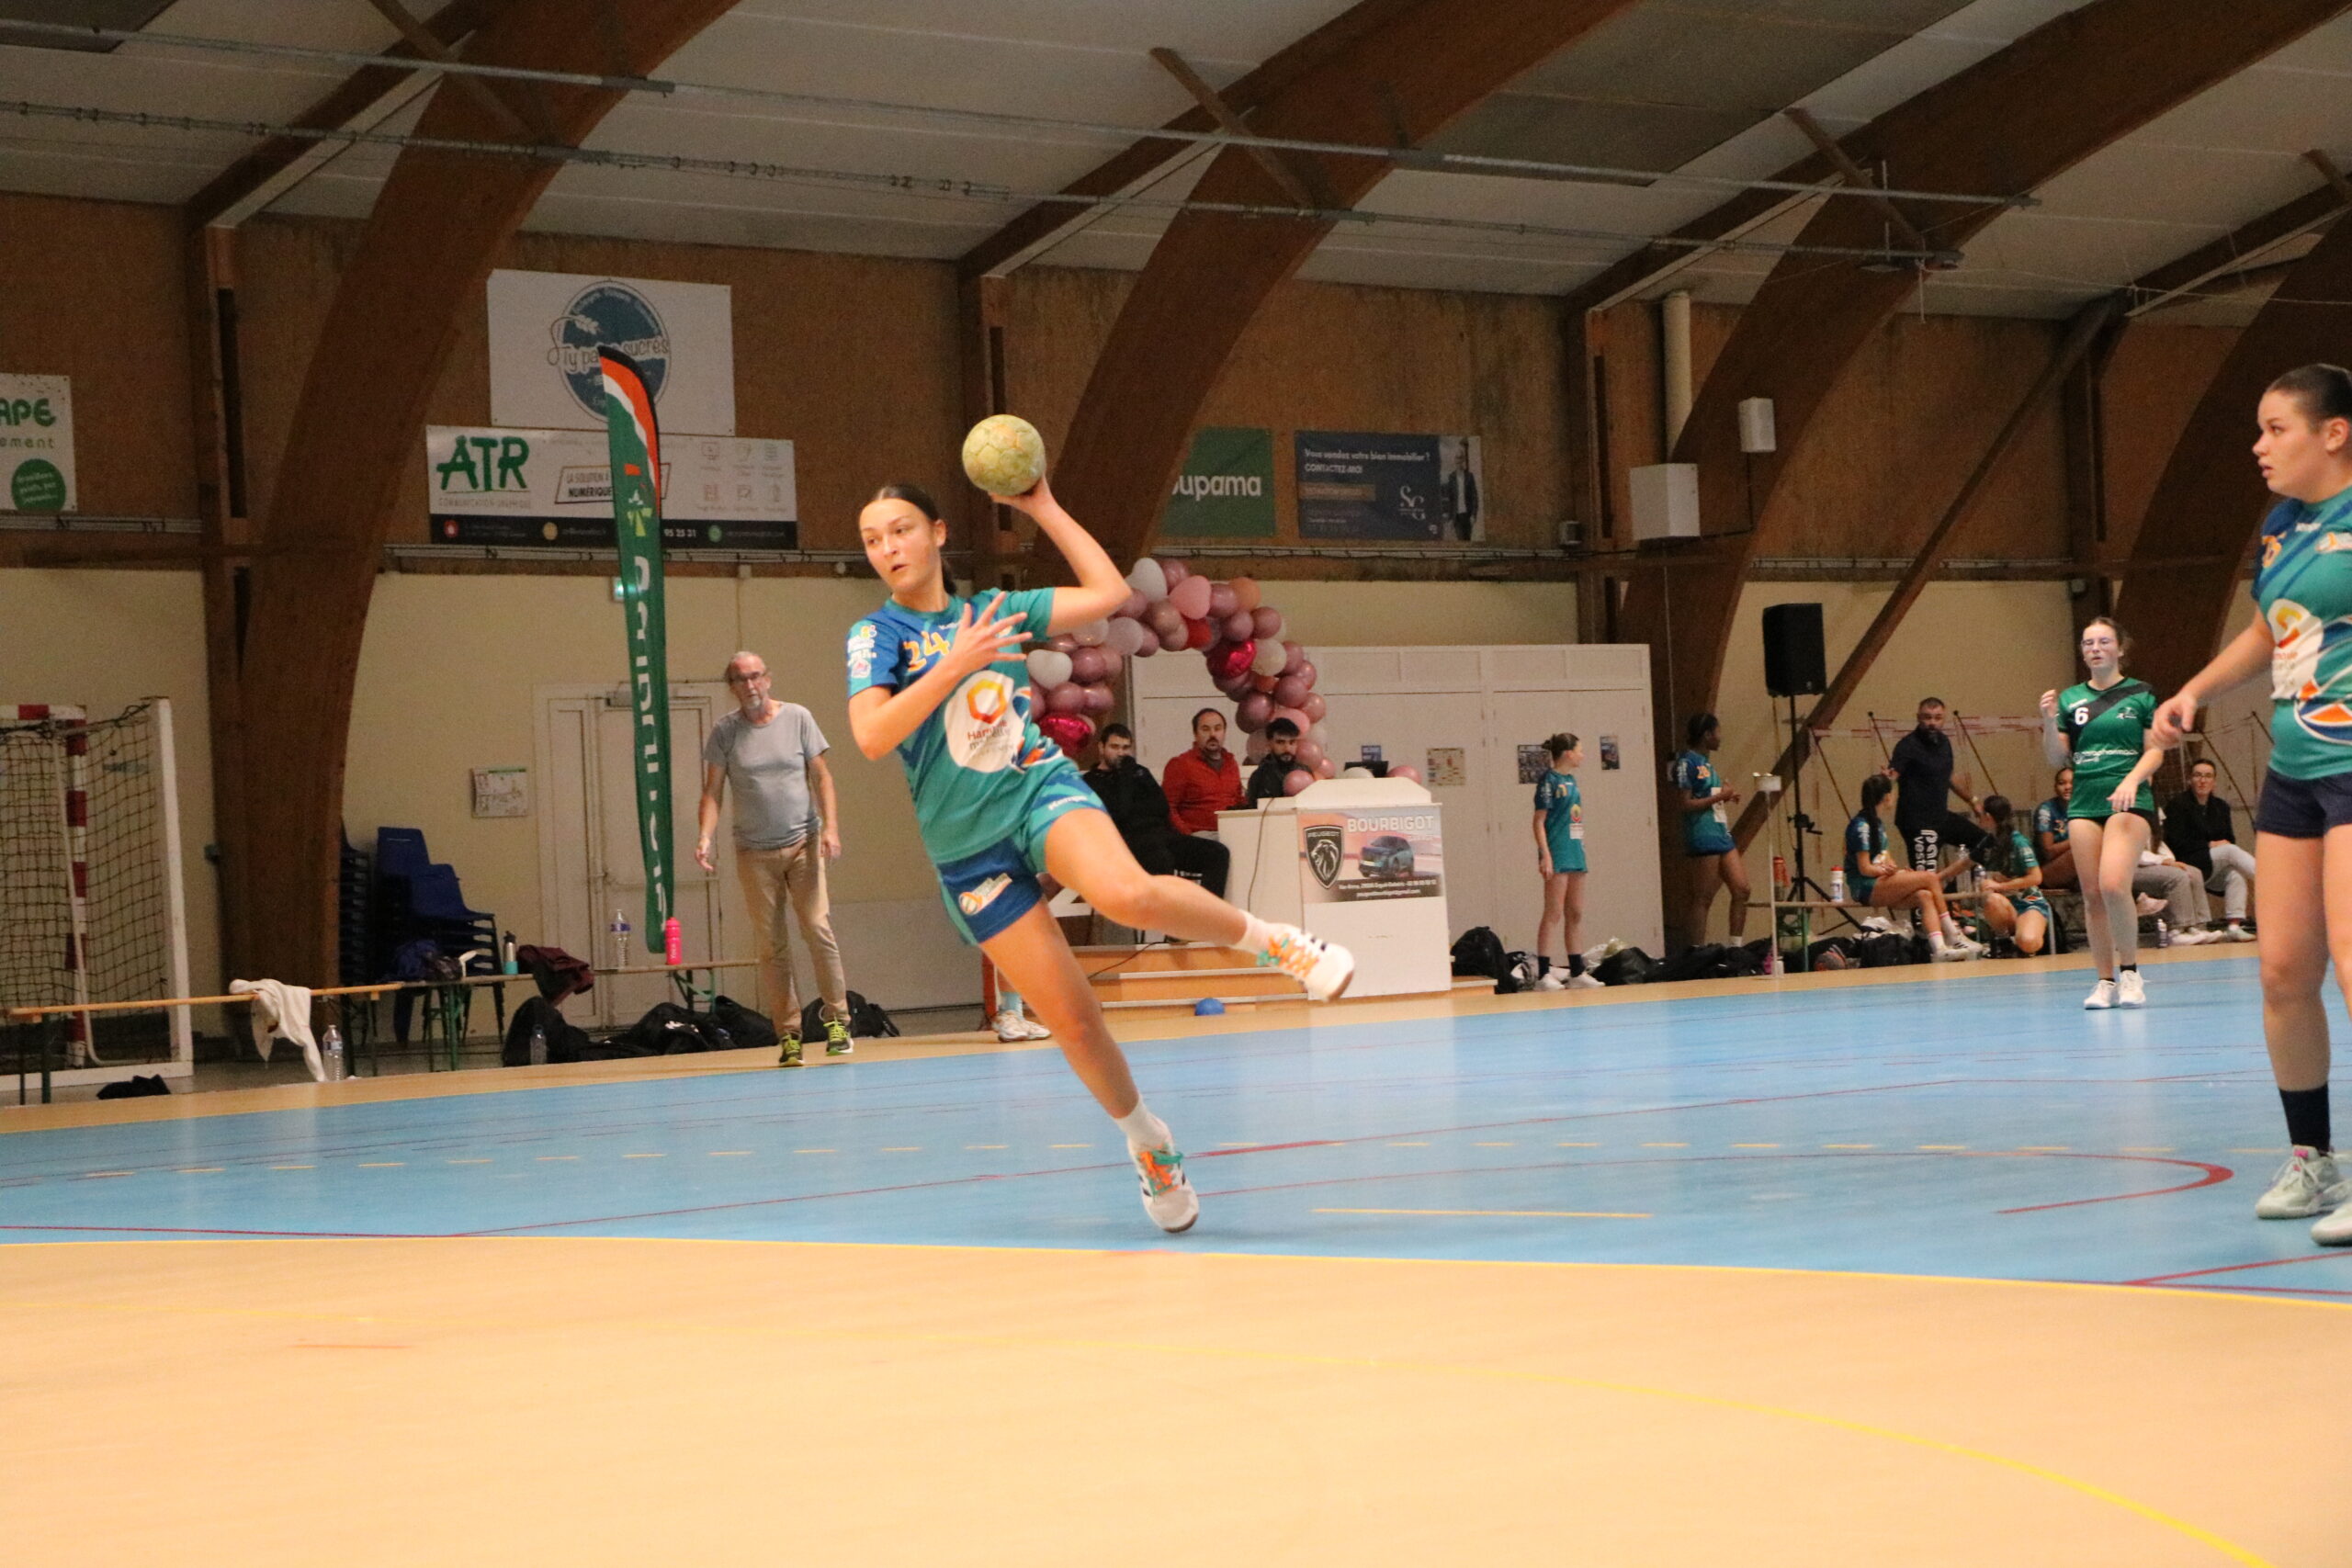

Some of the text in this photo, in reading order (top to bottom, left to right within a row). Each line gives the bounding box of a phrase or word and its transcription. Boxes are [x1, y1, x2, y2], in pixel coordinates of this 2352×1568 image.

[436, 434, 530, 491] ATR
[903, 630, 952, 672] 24
[2075, 706, 2089, 726] 6
[1347, 815, 1434, 833] BOURBIGOT
